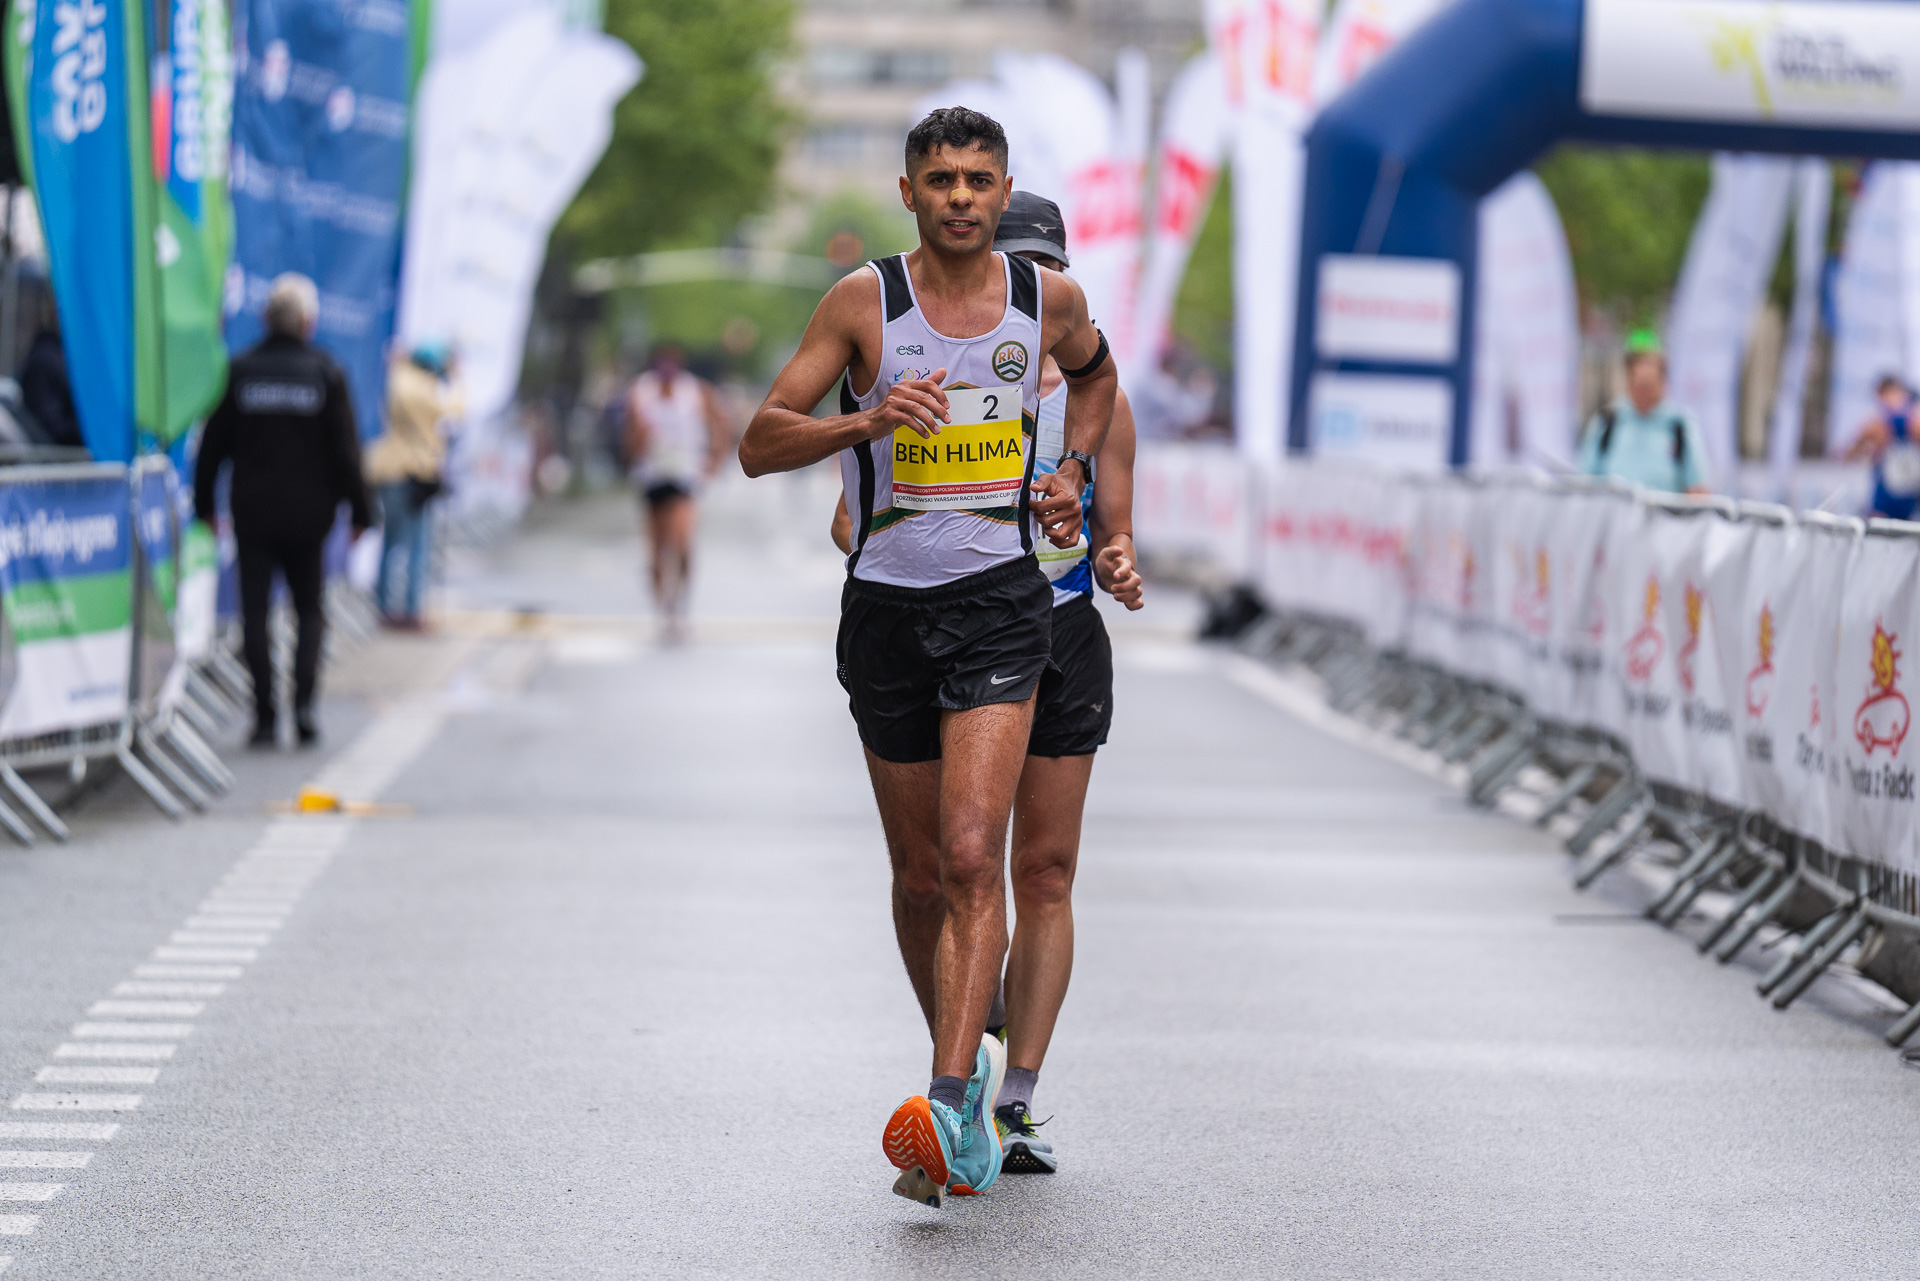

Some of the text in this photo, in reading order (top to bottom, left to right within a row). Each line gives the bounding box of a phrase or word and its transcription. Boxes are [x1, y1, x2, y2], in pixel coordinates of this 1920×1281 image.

[896, 345, 924, 356] esa
[998, 346, 1023, 363] RKS
[983, 395, 998, 420] 2
[895, 438, 1021, 464] BEN HLIMA
[975, 493, 998, 501] WALKING
